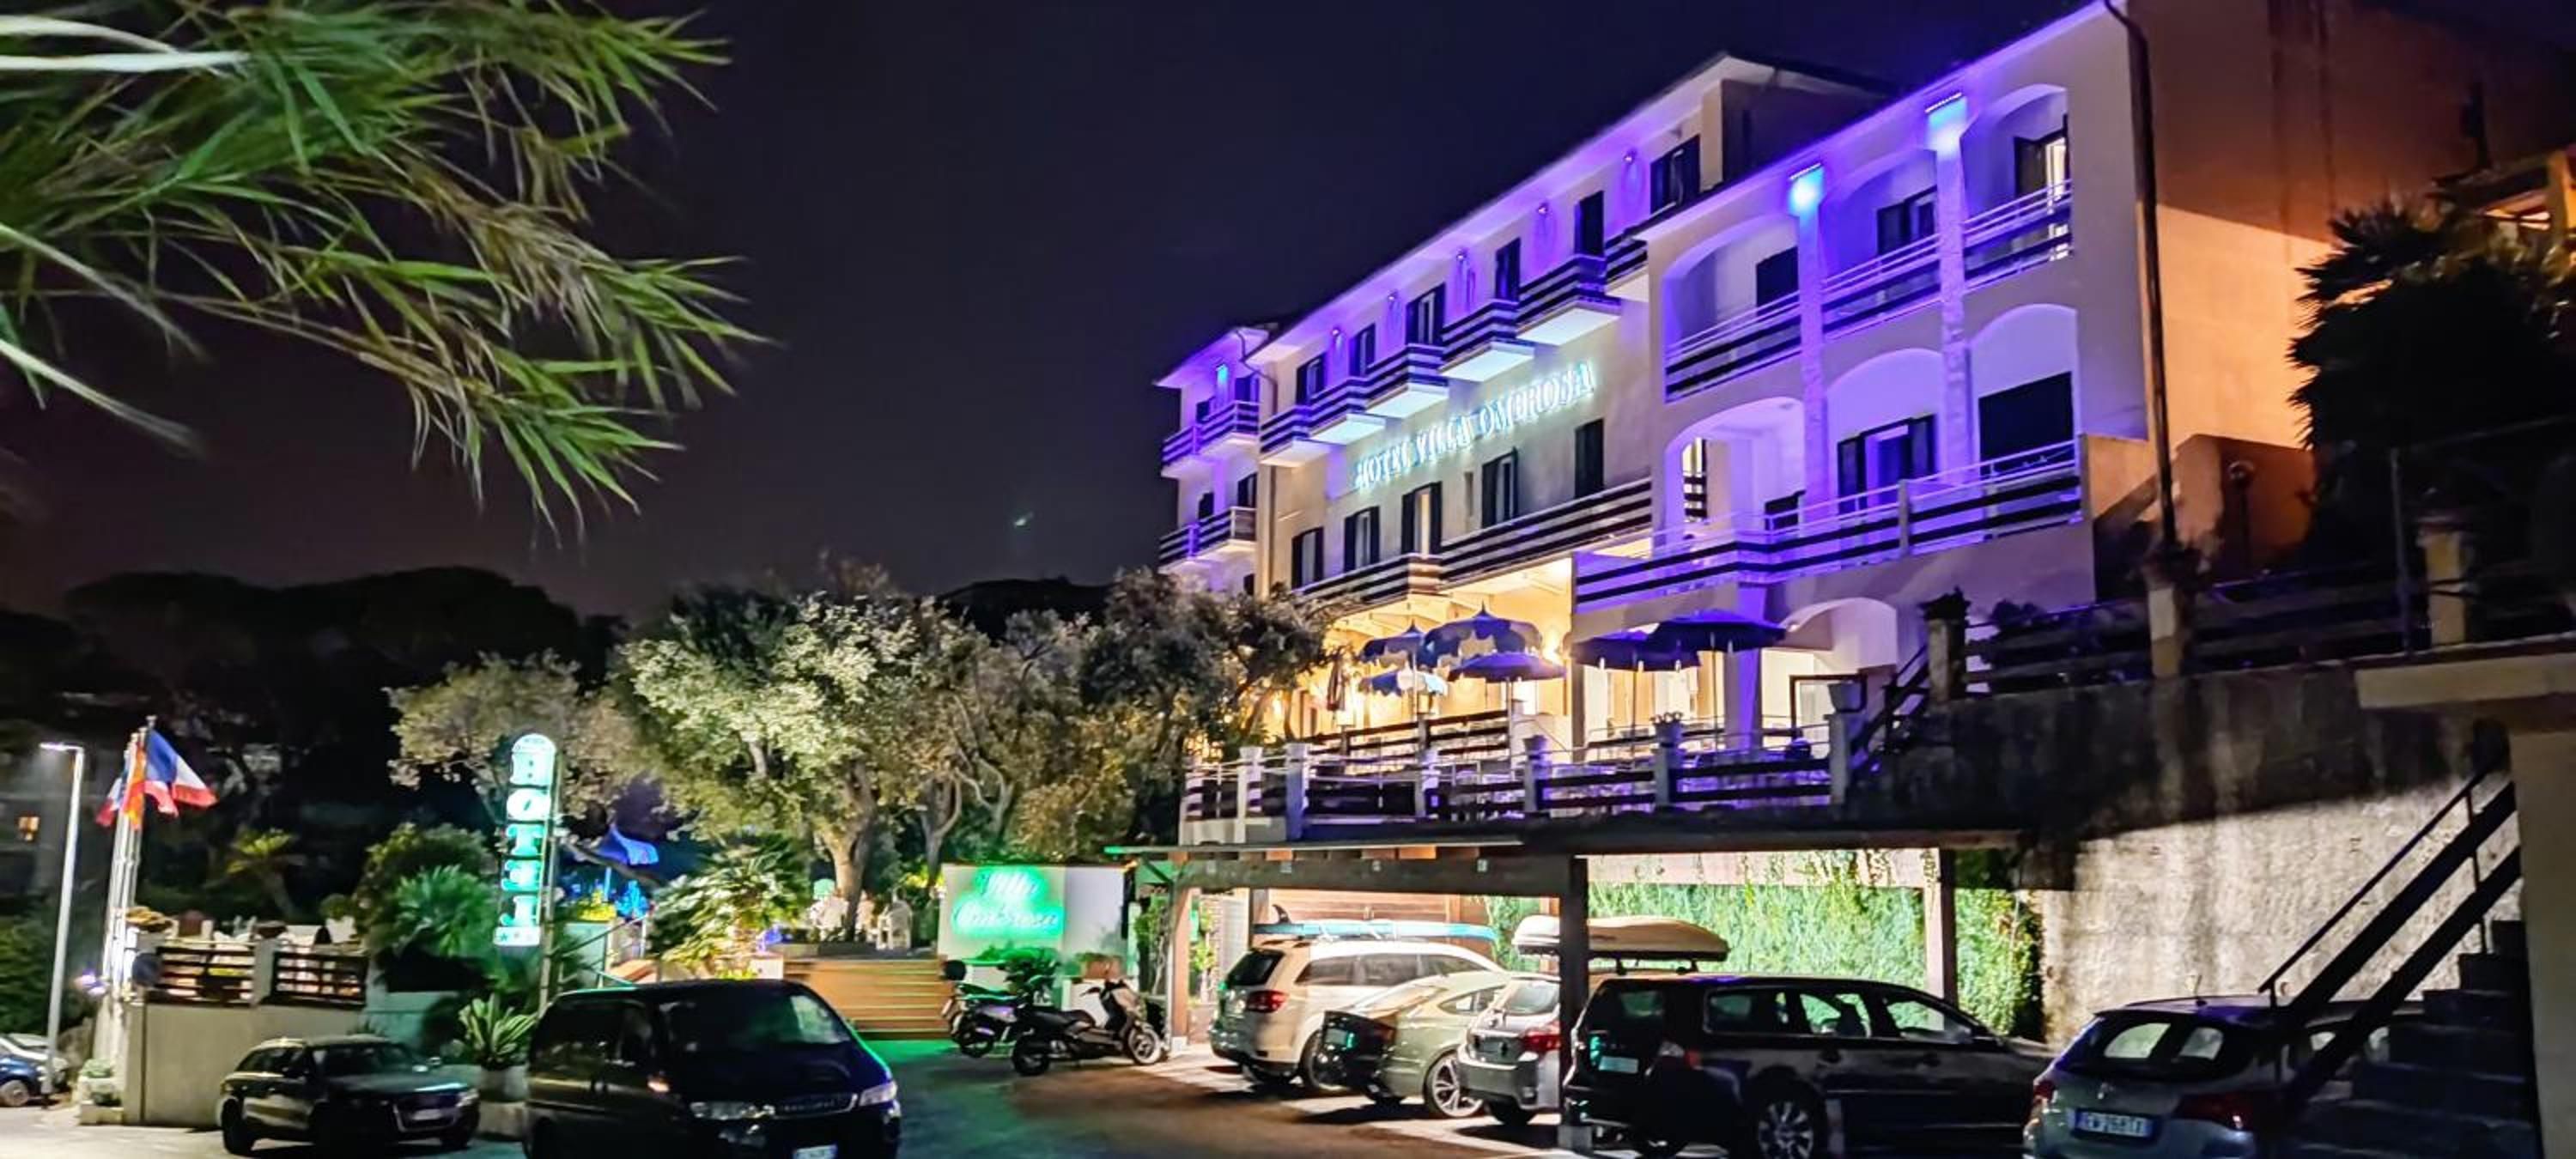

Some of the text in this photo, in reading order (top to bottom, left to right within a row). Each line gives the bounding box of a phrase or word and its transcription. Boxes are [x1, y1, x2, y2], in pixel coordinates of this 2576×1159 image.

[1354, 361, 1595, 489] HOTEL VILLA OMBROSA
[499, 752, 554, 926] HOTEL
